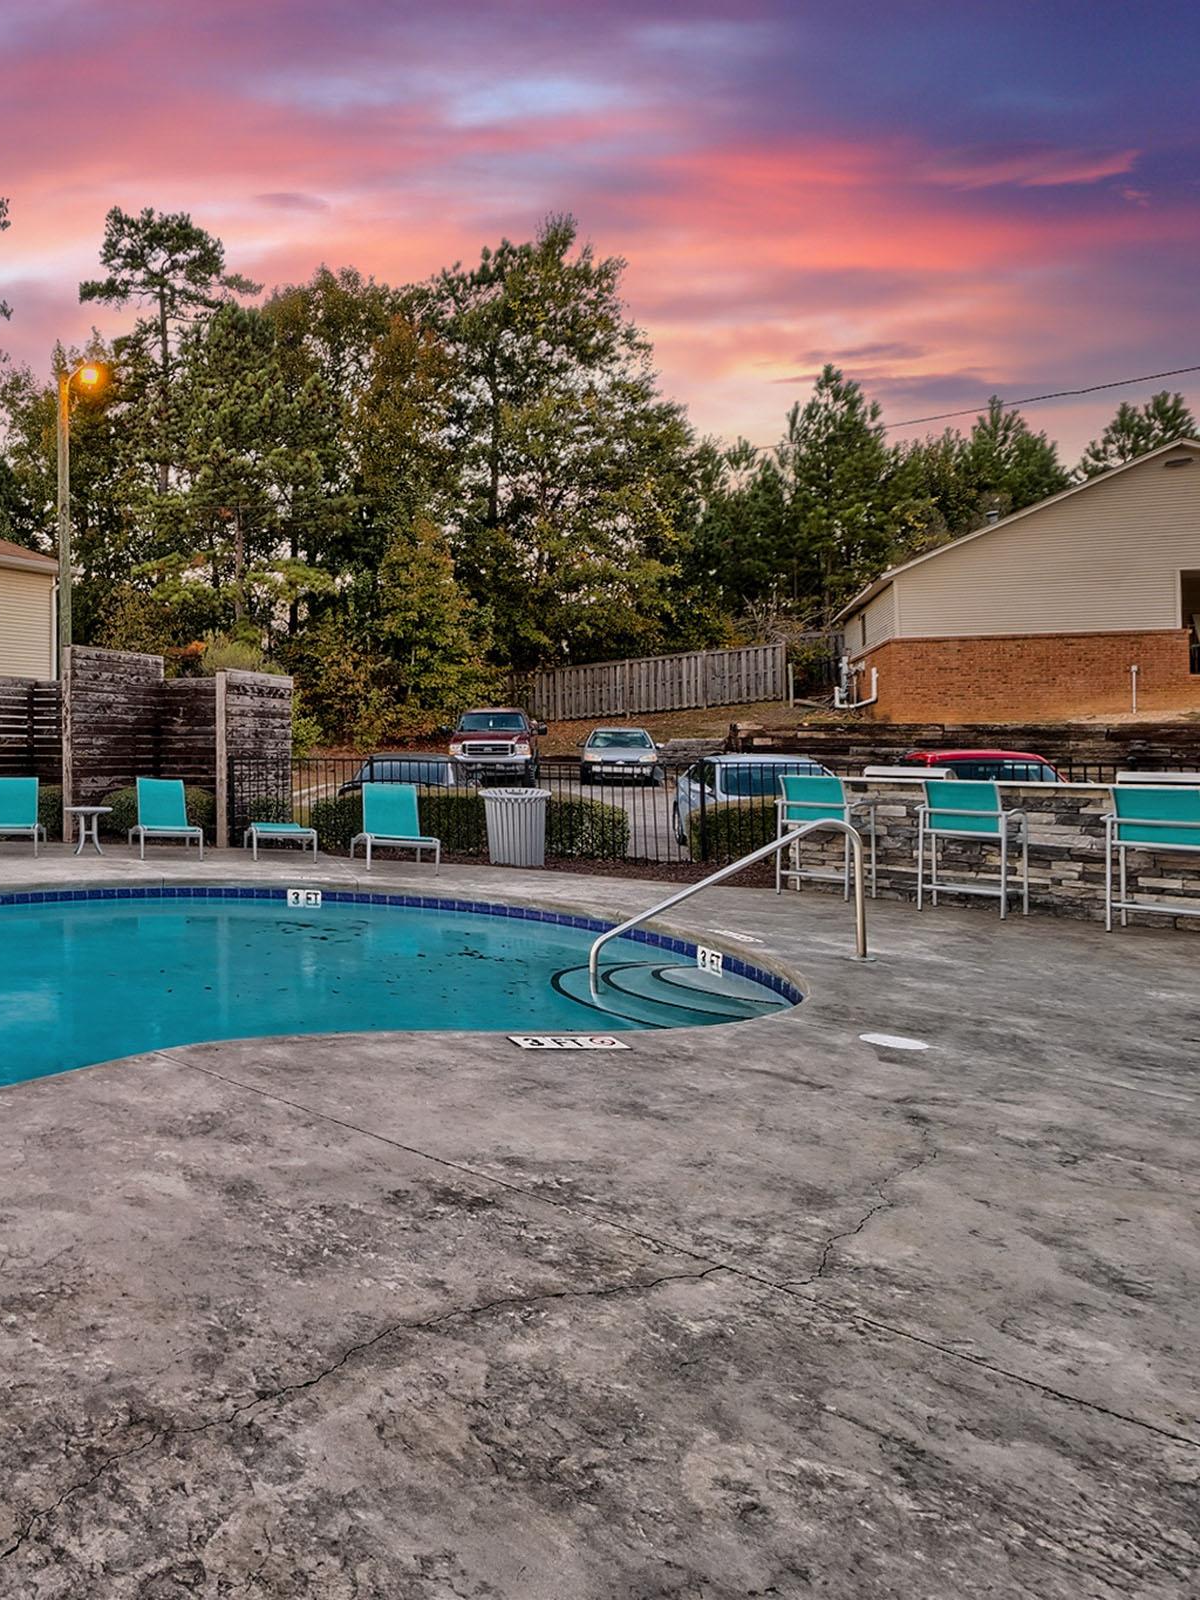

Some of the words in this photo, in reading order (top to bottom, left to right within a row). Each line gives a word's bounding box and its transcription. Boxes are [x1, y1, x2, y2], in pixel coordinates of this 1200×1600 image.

[291, 891, 300, 906] 3
[700, 950, 707, 968] 3
[523, 1037, 545, 1047] 3
[550, 1038, 583, 1047] FT
